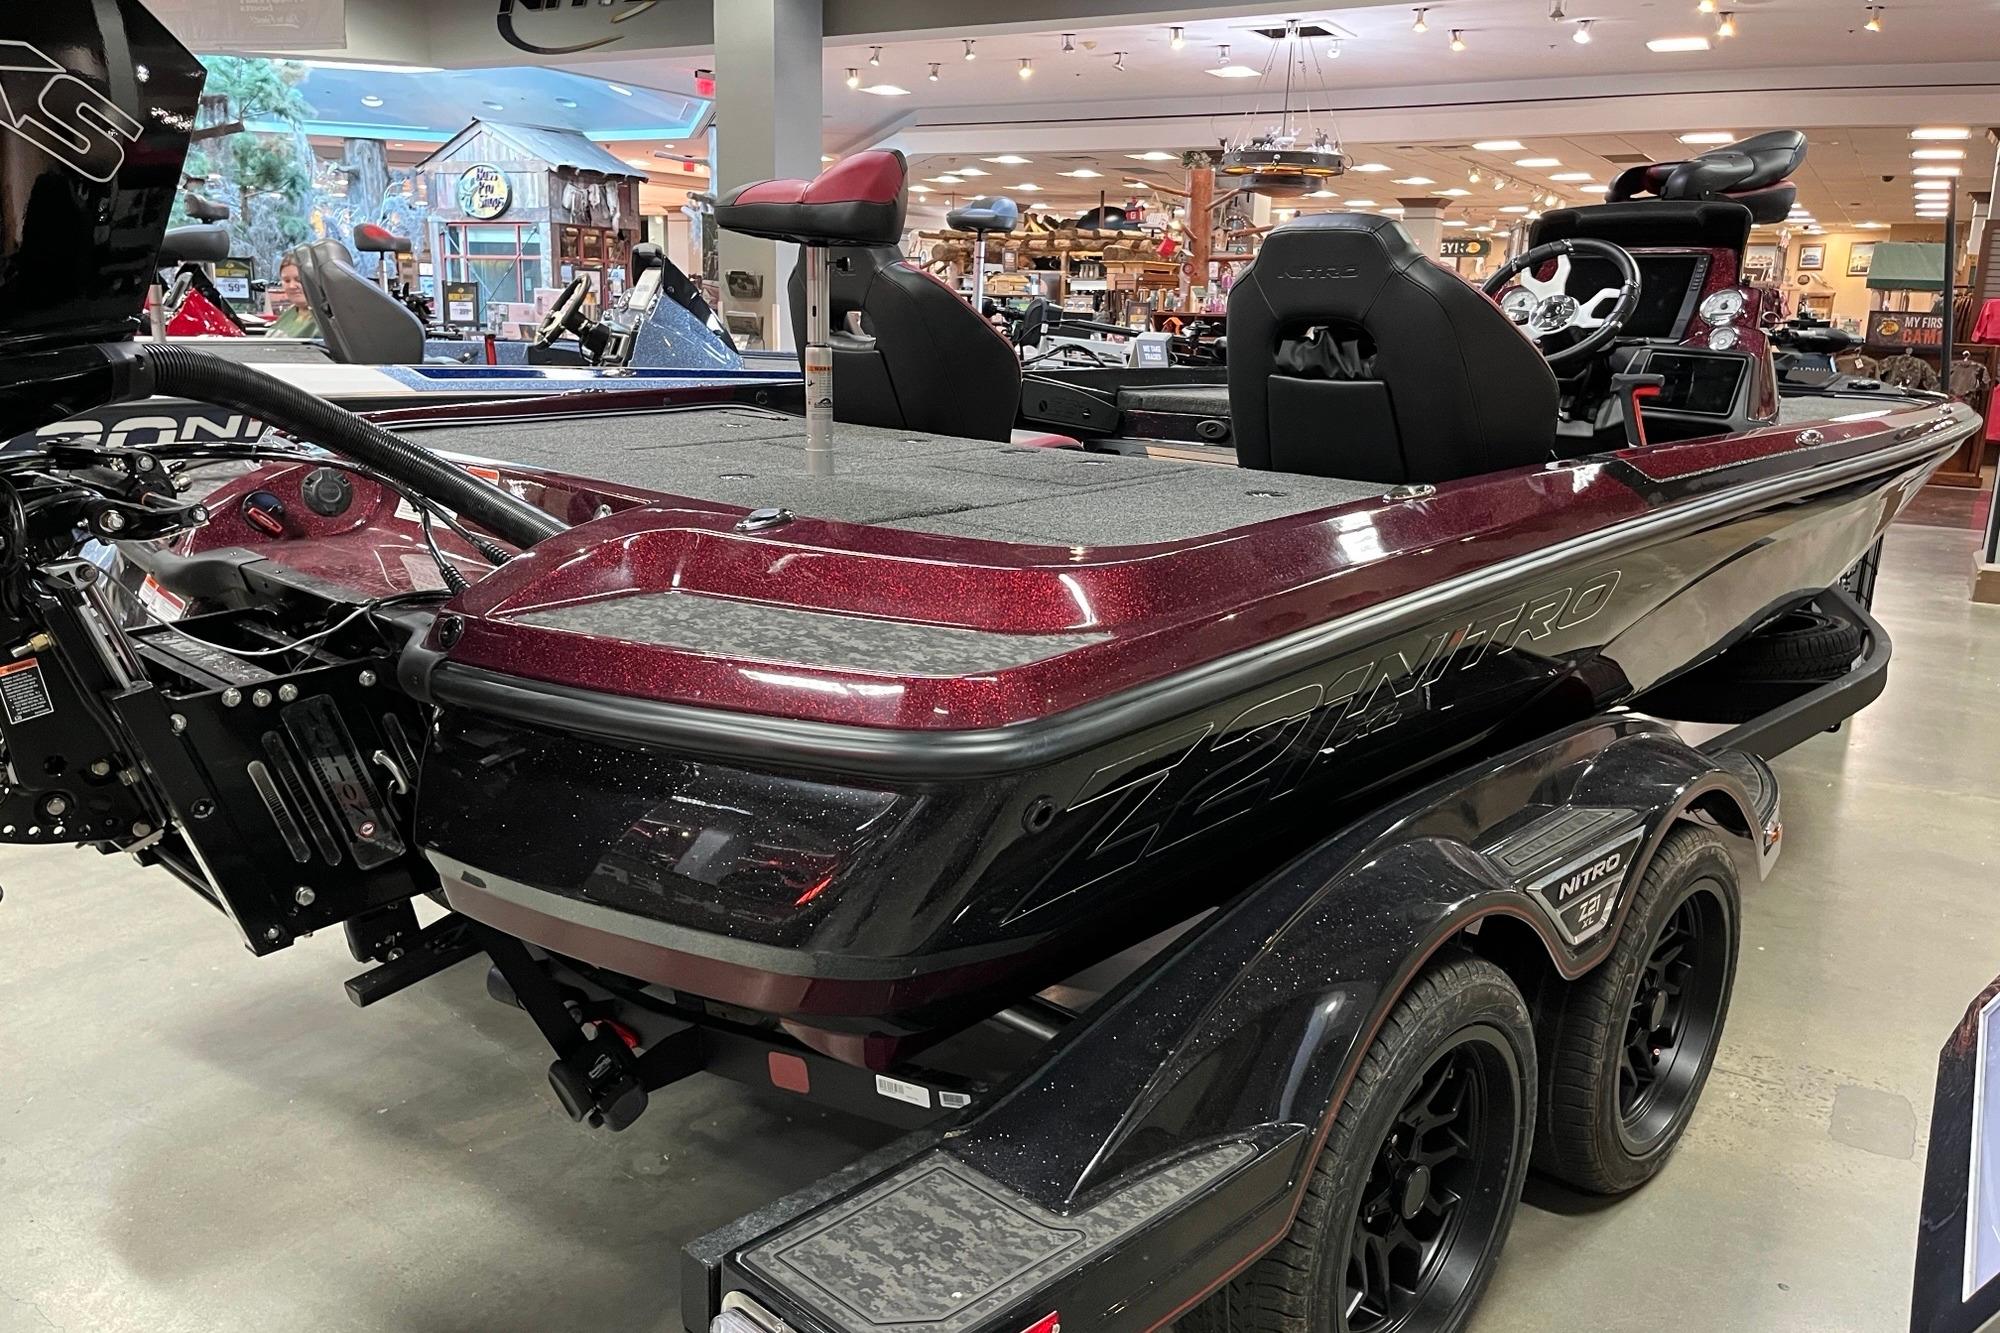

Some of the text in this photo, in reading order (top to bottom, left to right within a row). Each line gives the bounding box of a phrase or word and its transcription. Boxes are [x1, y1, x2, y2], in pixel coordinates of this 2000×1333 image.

[1440, 242, 1459, 254] EY!
[1904, 316, 1921, 328] MY
[1922, 317, 1944, 329] FIRS
[1346, 569, 1622, 719] NITRO
[1558, 852, 1621, 900] NITRO
[1577, 893, 1601, 923] Z21
